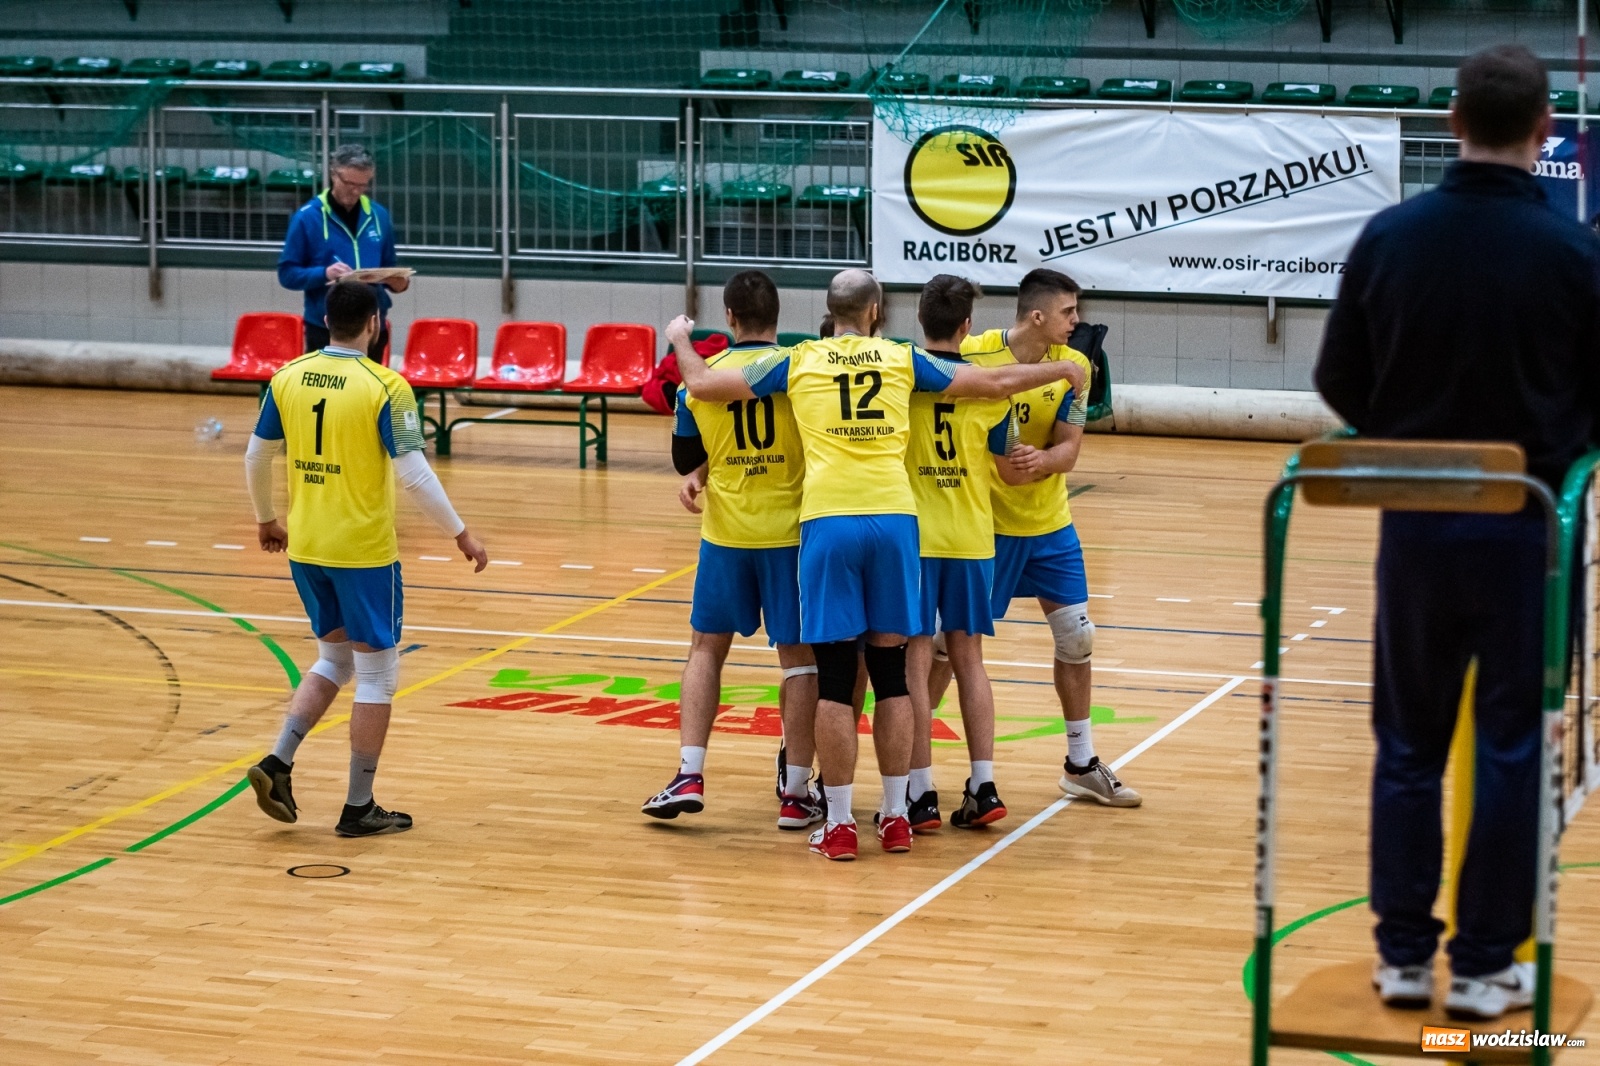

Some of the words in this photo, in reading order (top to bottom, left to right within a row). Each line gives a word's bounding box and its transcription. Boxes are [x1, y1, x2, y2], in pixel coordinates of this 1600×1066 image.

[1528, 159, 1585, 180] oma
[1038, 211, 1117, 257] JEST
[1125, 200, 1157, 232] W
[1167, 143, 1369, 222] PORZĄDKU!
[903, 238, 1018, 264] RACIBÓRZ
[301, 371, 347, 391] FERDYAN
[832, 370, 886, 421] 12
[726, 393, 776, 451] 10
[1015, 402, 1030, 424] 13
[312, 398, 327, 456] 1
[934, 402, 957, 462] 5
[725, 454, 765, 467] SIATKARSKI
[766, 454, 785, 464] KLUB
[918, 466, 959, 477] SIATKARSKI
[936, 478, 961, 488] RADLIN
